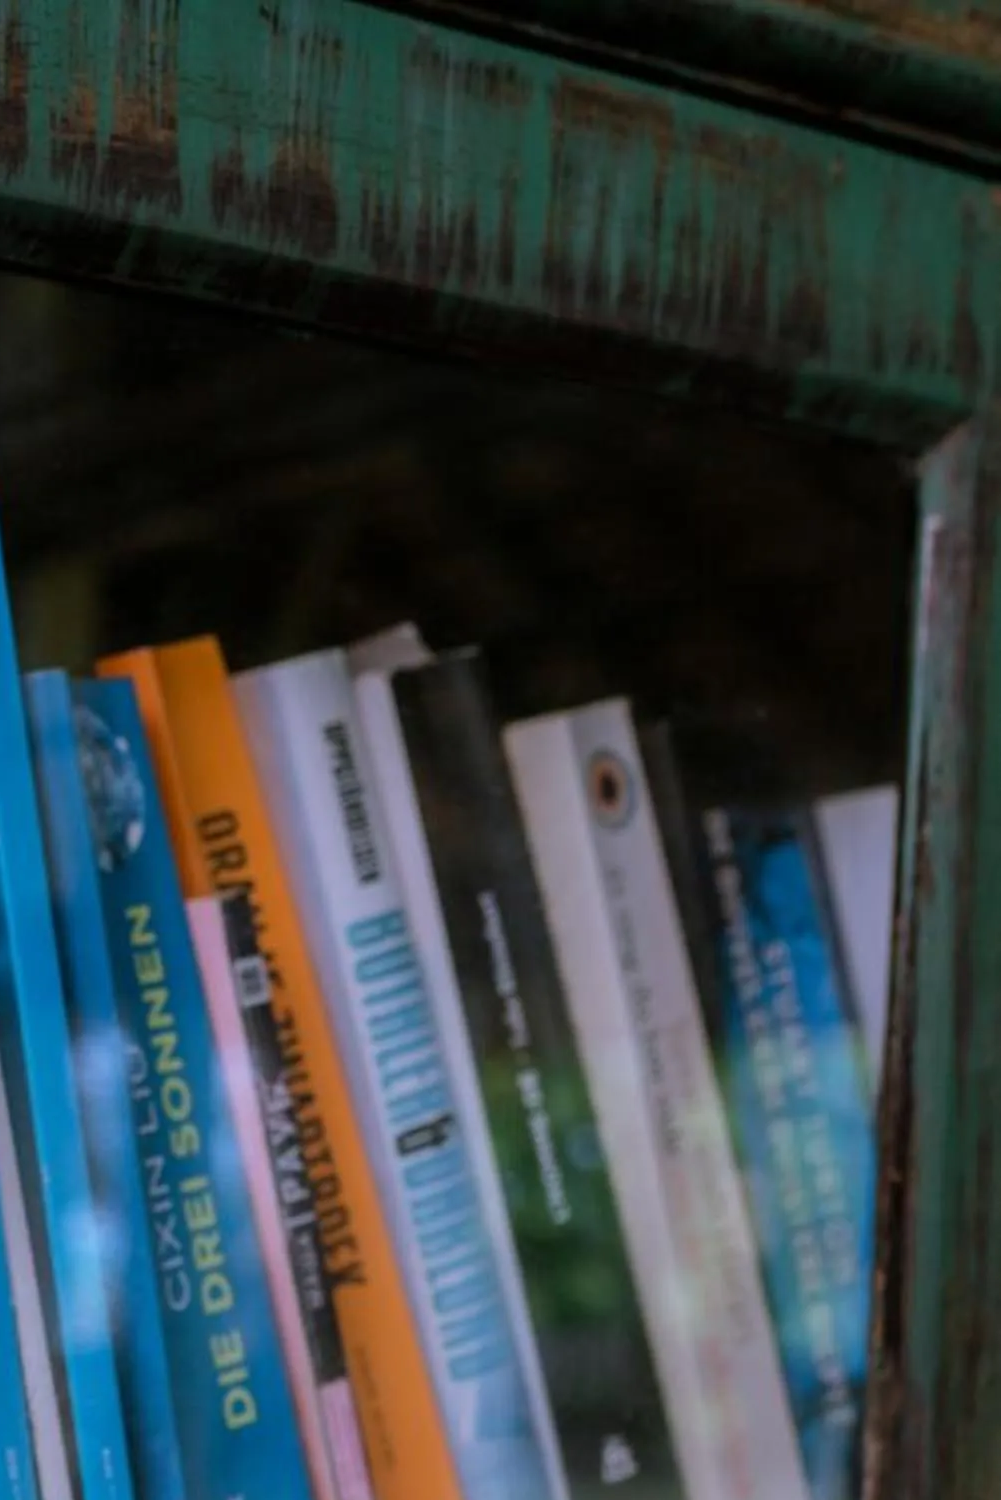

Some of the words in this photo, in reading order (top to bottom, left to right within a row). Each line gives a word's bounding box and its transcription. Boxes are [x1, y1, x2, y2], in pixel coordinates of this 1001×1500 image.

[121, 901, 204, 1160] SONNEN
[123, 1043, 159, 1135] LIU
[142, 1154, 194, 1313] CIXIN
[178, 1172, 236, 1314] DREI
[209, 1327, 260, 1430] DIE
